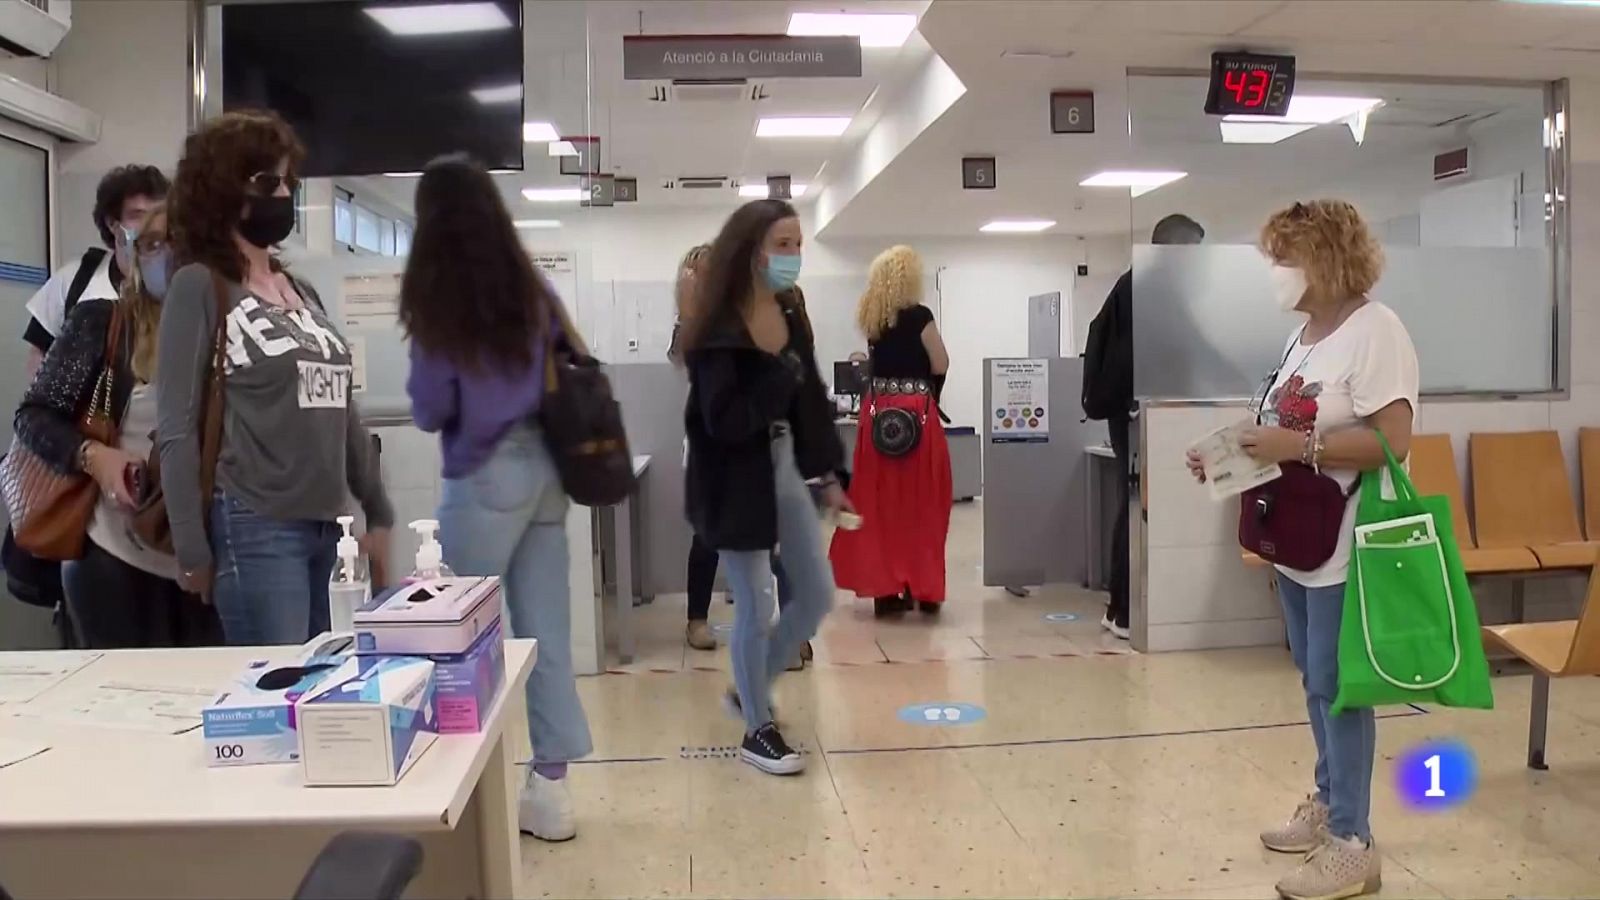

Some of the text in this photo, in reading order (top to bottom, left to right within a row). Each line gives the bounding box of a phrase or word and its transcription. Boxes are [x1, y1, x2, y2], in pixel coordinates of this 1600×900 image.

[662, 51, 716, 64] Atenció
[719, 52, 728, 63] a
[732, 51, 745, 64] la
[1242, 62, 1275, 72] TURNO
[1224, 70, 1269, 107] 43
[1067, 106, 1080, 125] 6
[975, 168, 985, 183] 5
[592, 184, 602, 198] 2
[621, 186, 629, 198] 3
[215, 744, 244, 759] 100
